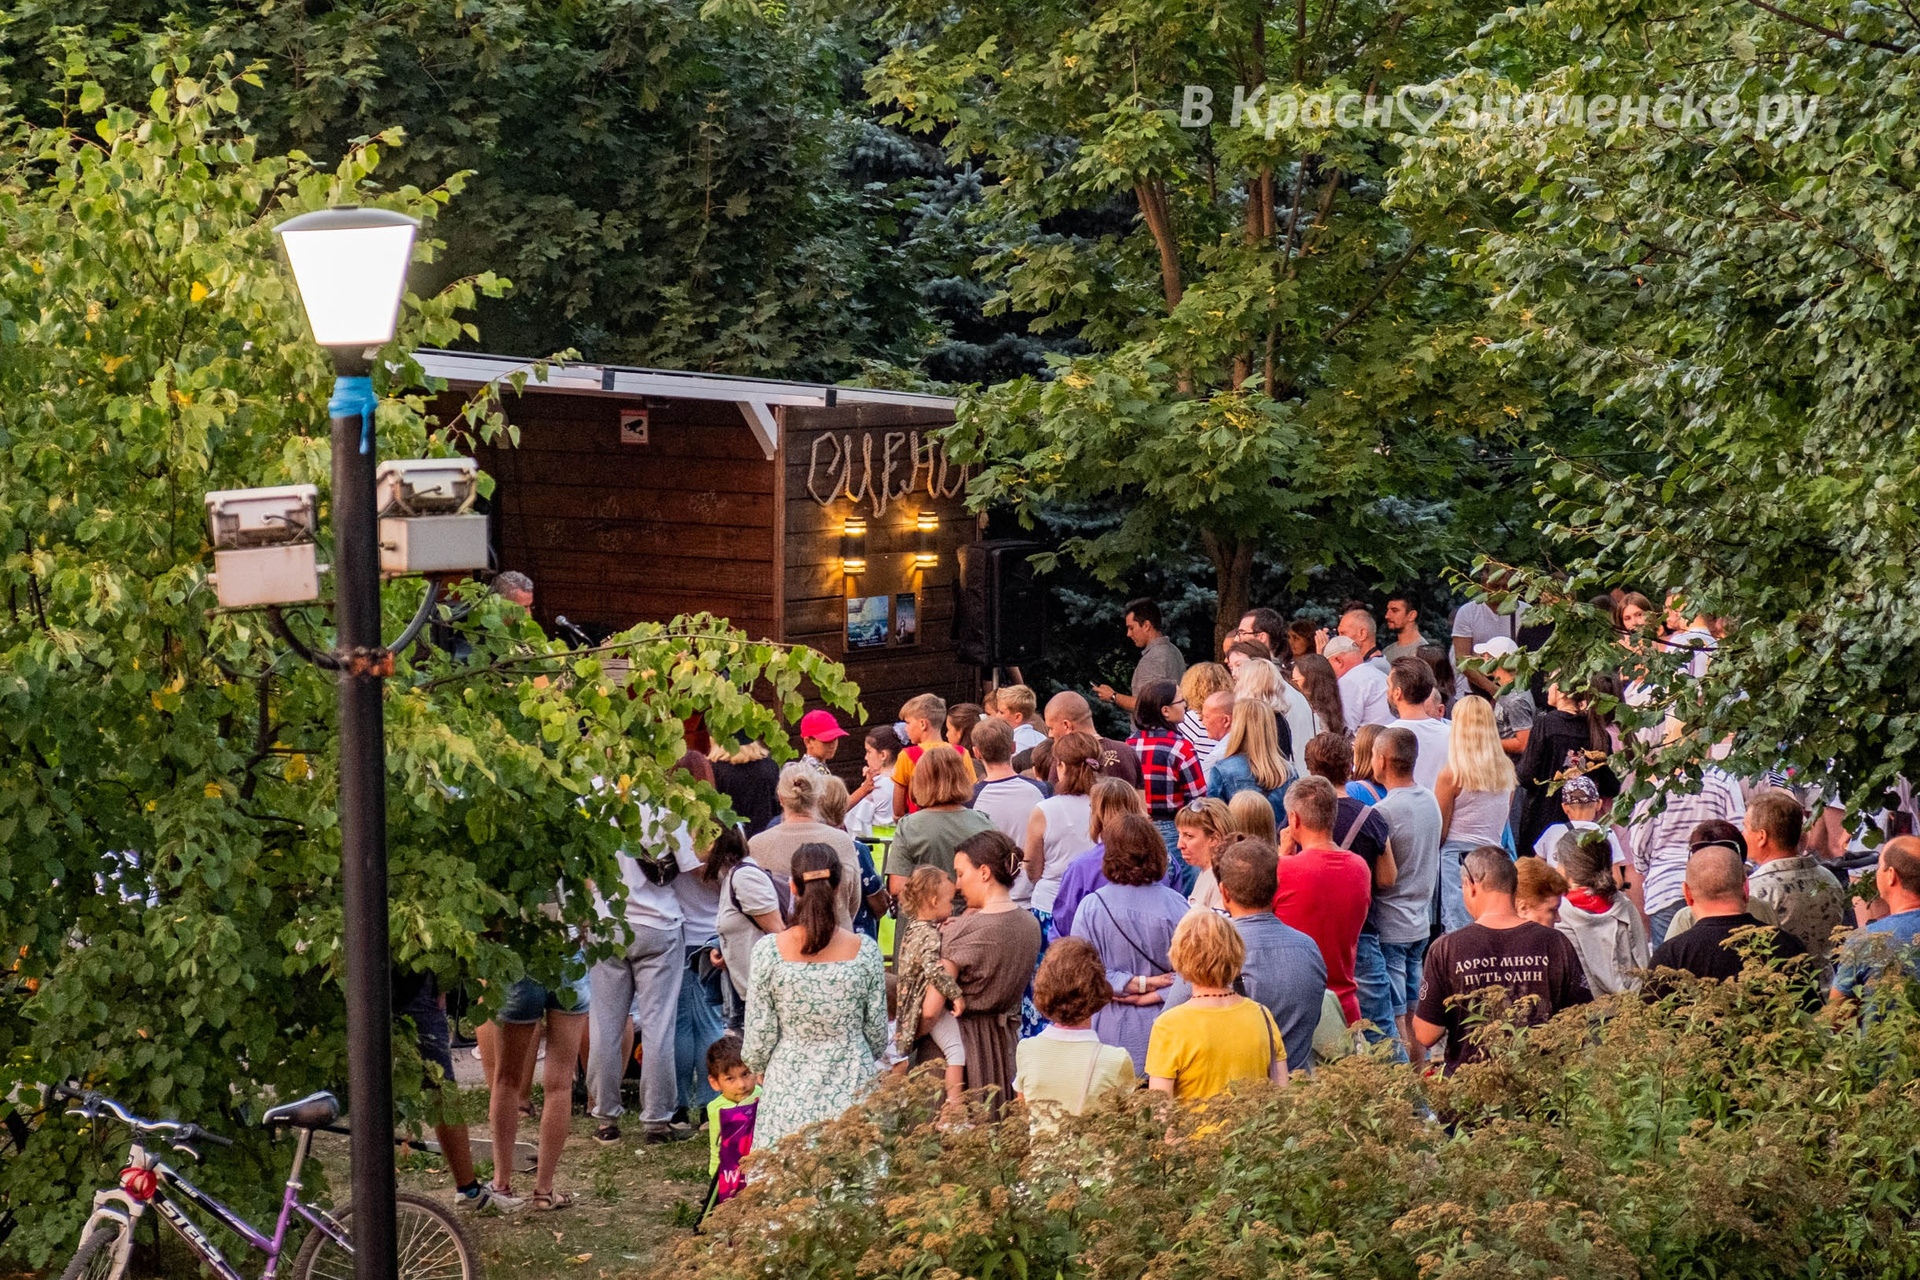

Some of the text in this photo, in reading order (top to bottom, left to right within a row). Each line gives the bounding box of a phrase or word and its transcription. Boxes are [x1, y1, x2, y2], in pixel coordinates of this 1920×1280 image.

[1455, 955, 1549, 974] ДОРОГ МНОГО
[1464, 971, 1543, 986] ПУТЬ ОДИН
[156, 1199, 222, 1263] STELS
